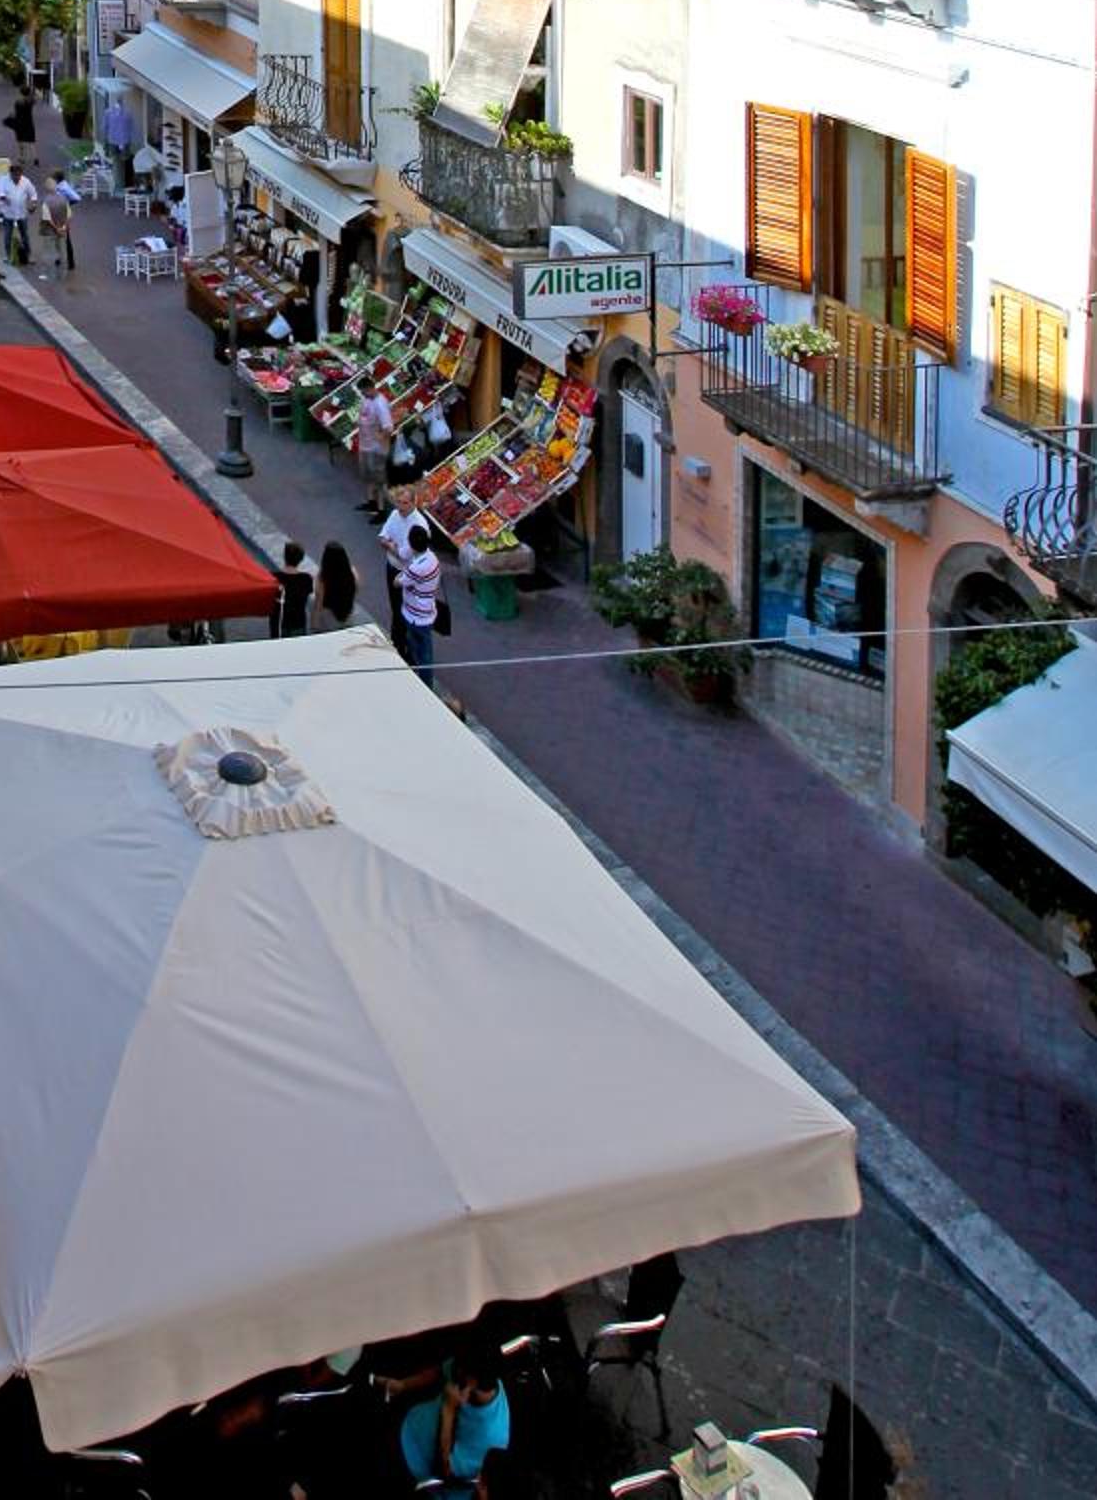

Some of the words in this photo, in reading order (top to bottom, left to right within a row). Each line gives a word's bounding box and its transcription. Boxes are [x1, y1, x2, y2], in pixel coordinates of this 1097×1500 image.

[527, 265, 642, 296] Alitalia
[591, 294, 643, 311] agente
[496, 313, 534, 351] FRUTTA
